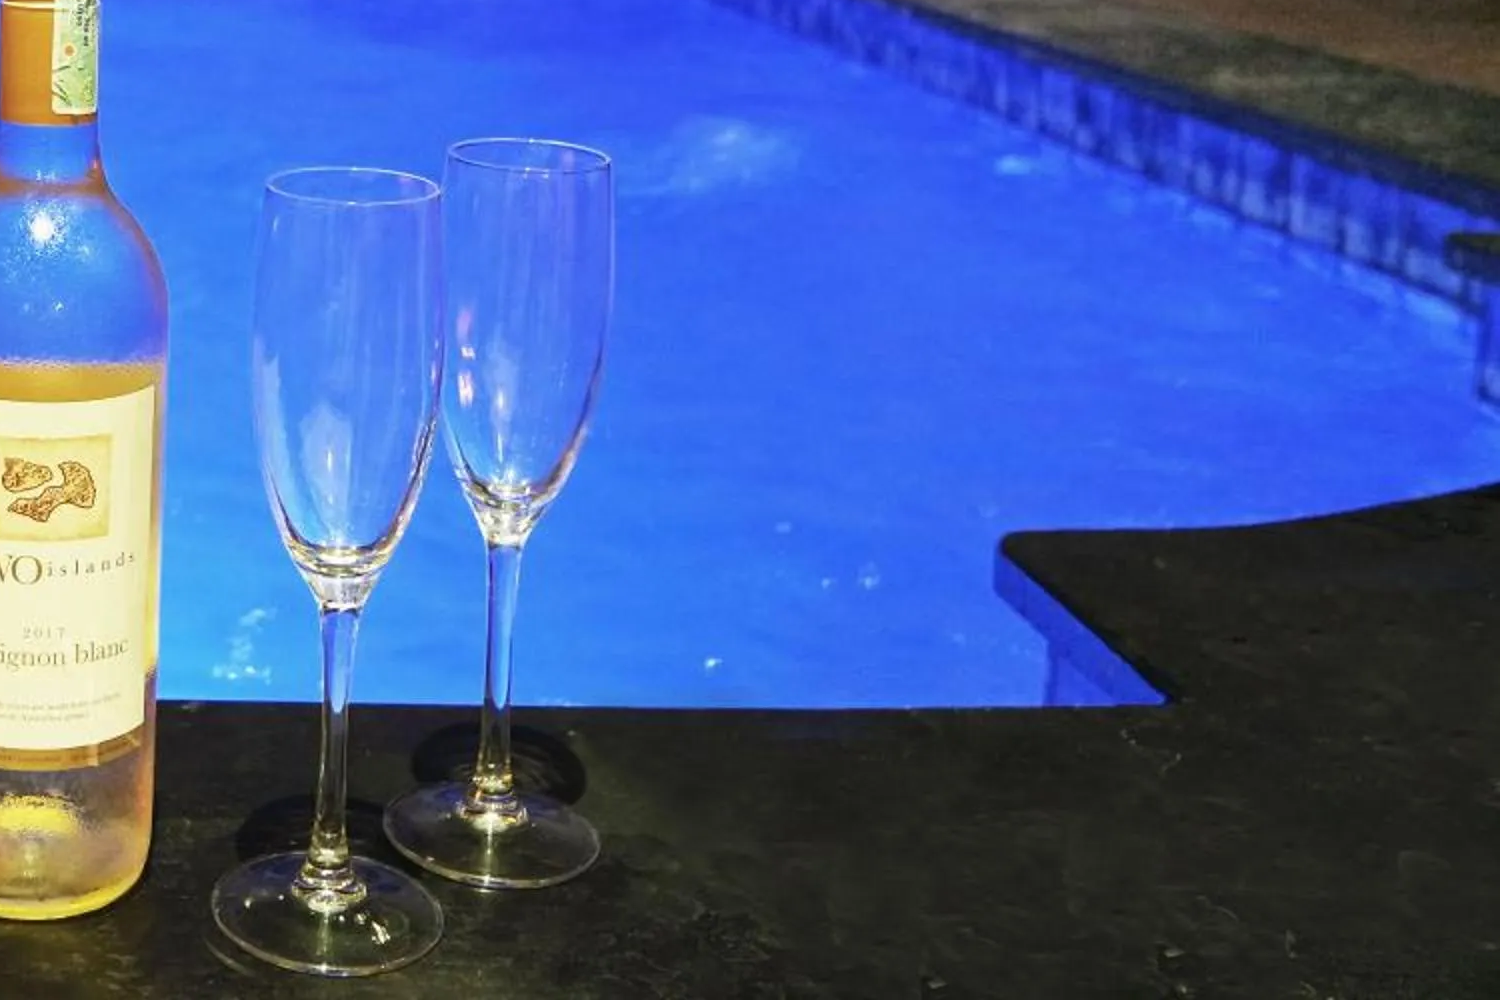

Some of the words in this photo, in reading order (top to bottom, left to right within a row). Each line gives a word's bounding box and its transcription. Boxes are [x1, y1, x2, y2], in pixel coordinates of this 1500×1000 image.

[46, 552, 136, 578] islands
[22, 627, 66, 640] 2017
[74, 637, 130, 665] blanc
